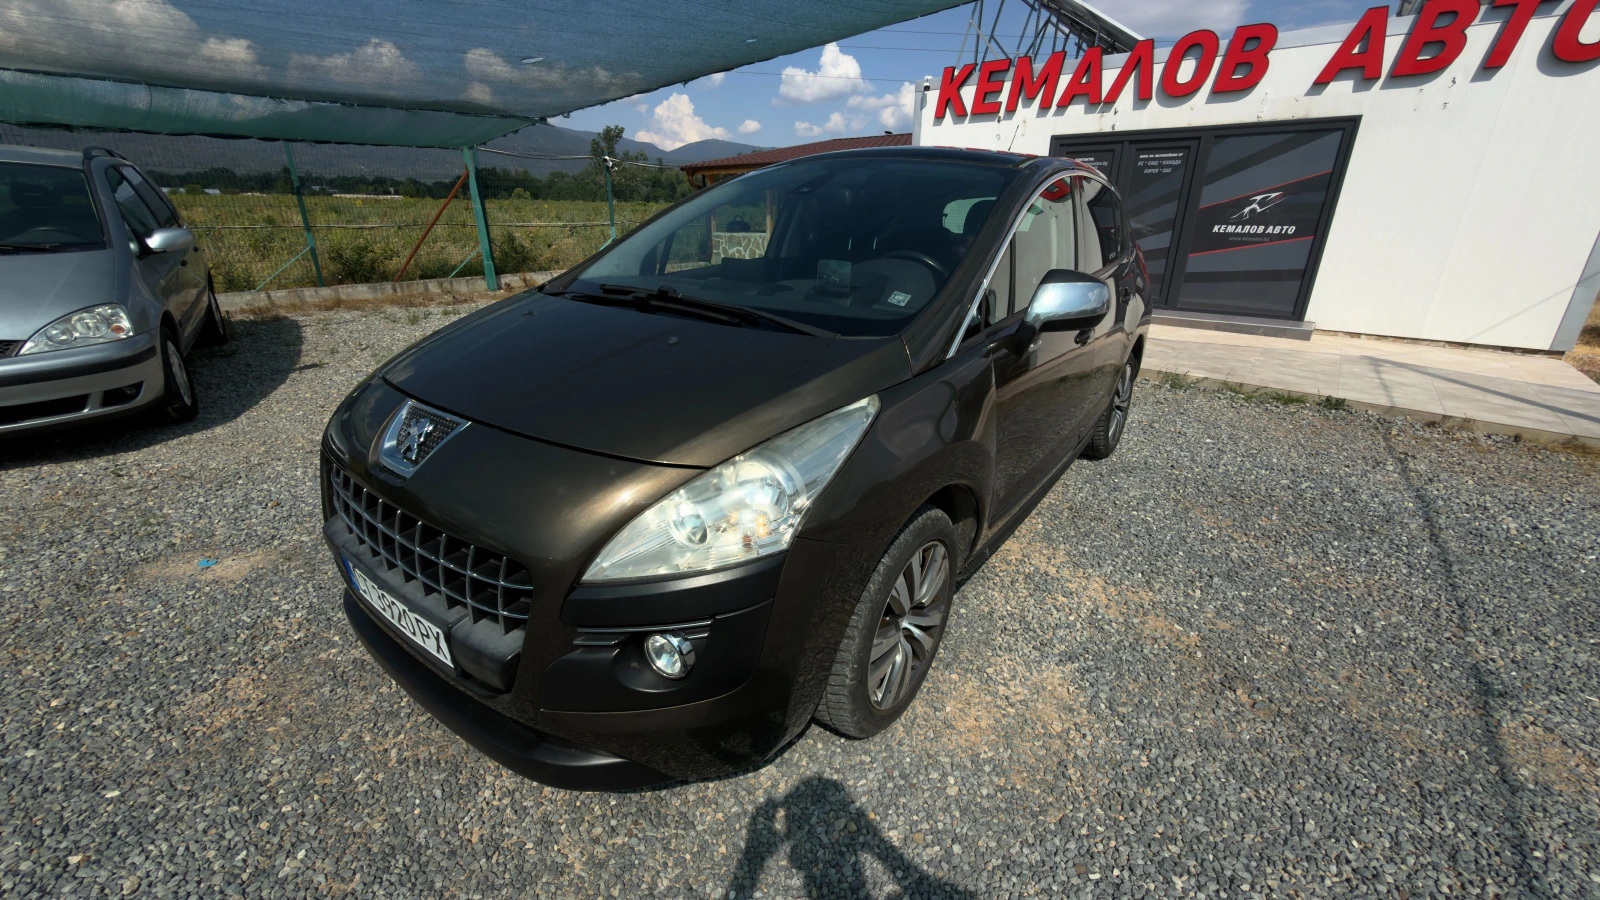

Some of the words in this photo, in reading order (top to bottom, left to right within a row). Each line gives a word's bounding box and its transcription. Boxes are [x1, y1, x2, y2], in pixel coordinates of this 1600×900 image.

[934, 22, 1278, 119] КЕМАЛОВ
[1212, 225, 1265, 234] КЕМАЛОВ
[1265, 225, 1296, 234] АВТО
[371, 584, 417, 638] 3920
[414, 615, 450, 661] PX
